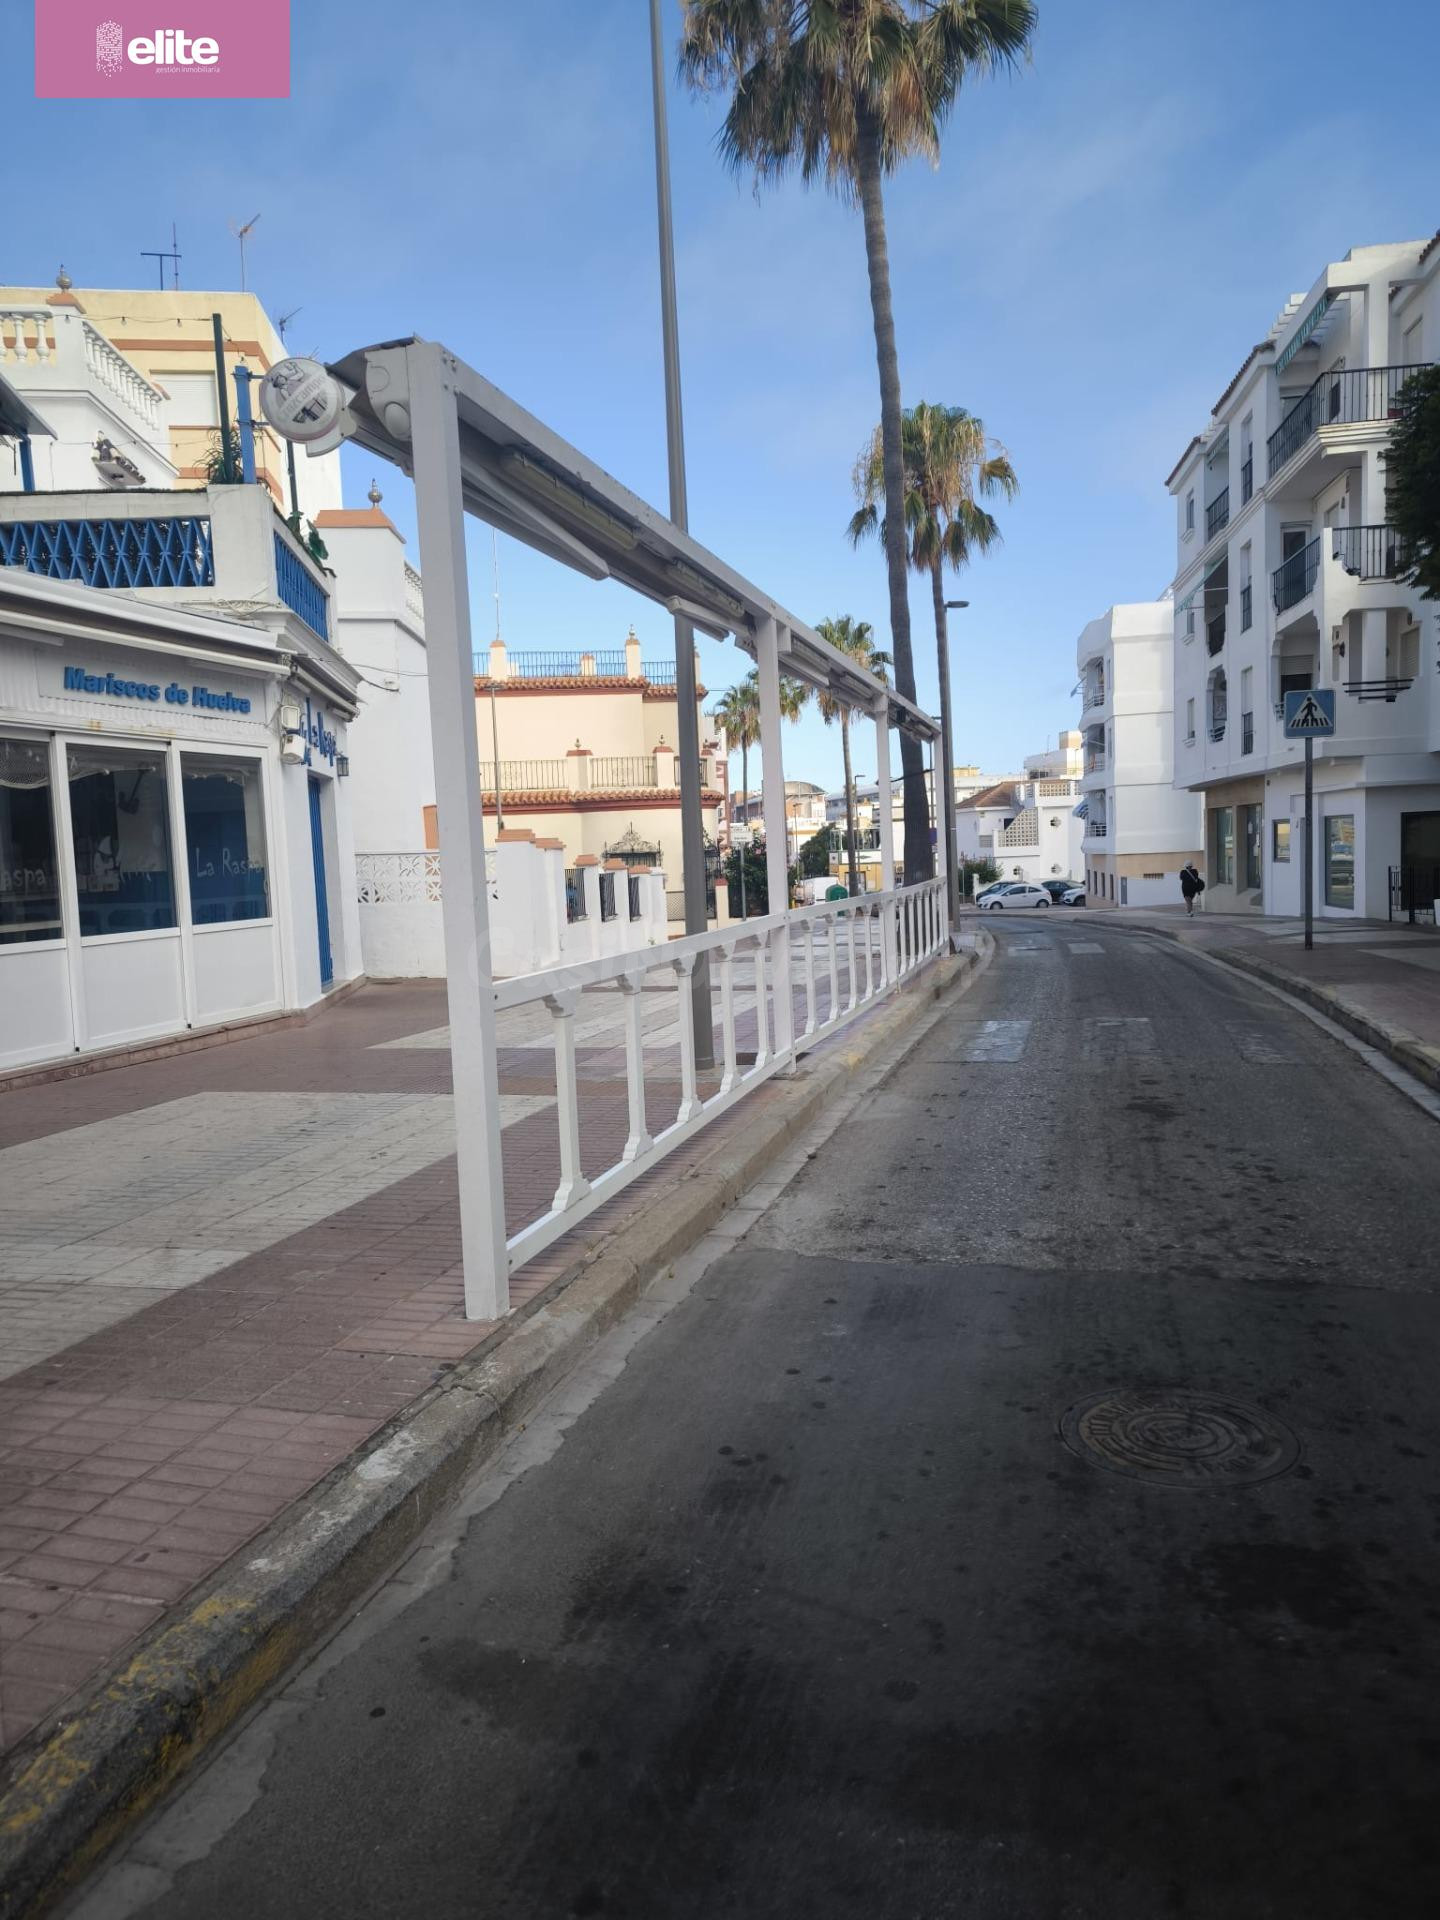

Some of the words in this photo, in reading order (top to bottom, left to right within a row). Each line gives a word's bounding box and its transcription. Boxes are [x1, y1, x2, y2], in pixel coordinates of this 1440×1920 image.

[64, 666, 160, 701] Mariscos
[165, 682, 189, 704] de
[192, 686, 251, 713] Huelva
[196, 847, 215, 878] La
[0, 867, 47, 896] aspa
